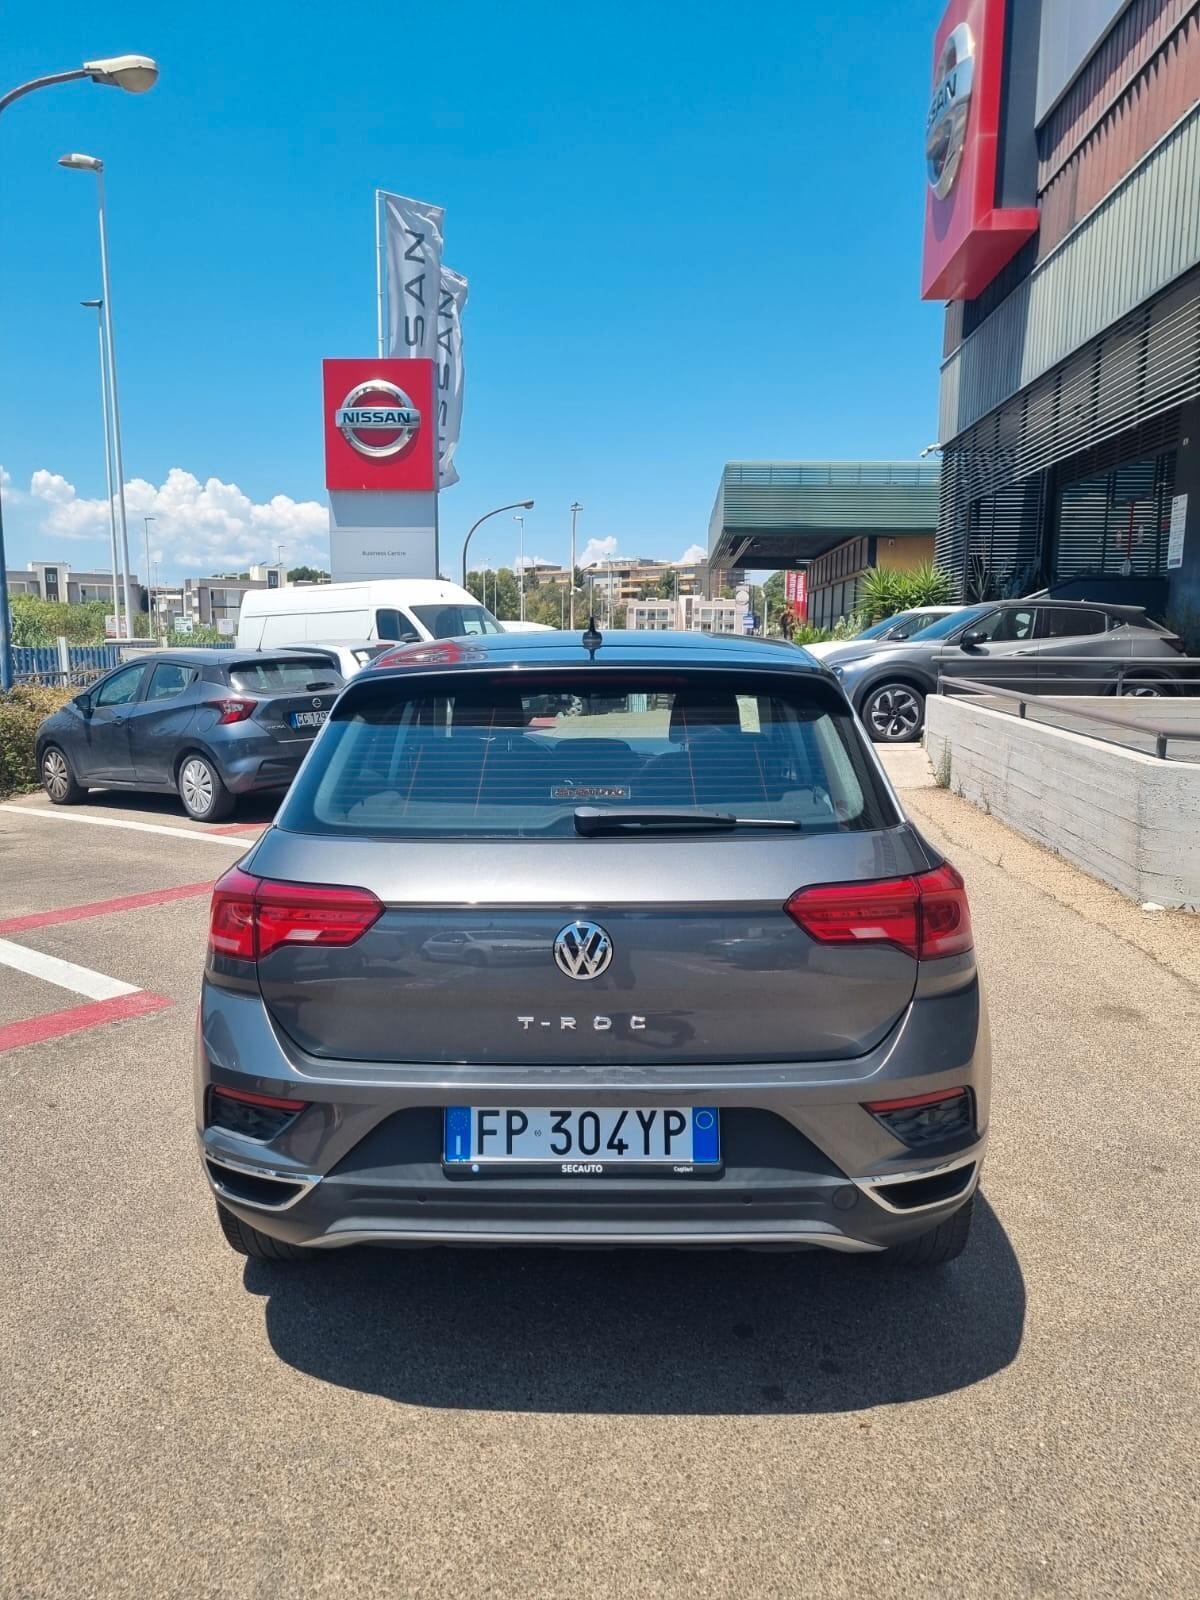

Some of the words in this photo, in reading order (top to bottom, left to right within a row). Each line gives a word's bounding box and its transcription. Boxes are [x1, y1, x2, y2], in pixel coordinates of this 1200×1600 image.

[404, 228, 426, 348] SAN
[342, 411, 411, 424] NISSAN
[517, 1016, 646, 1030] T-ROC
[561, 1164, 603, 1173] SECAUTO
